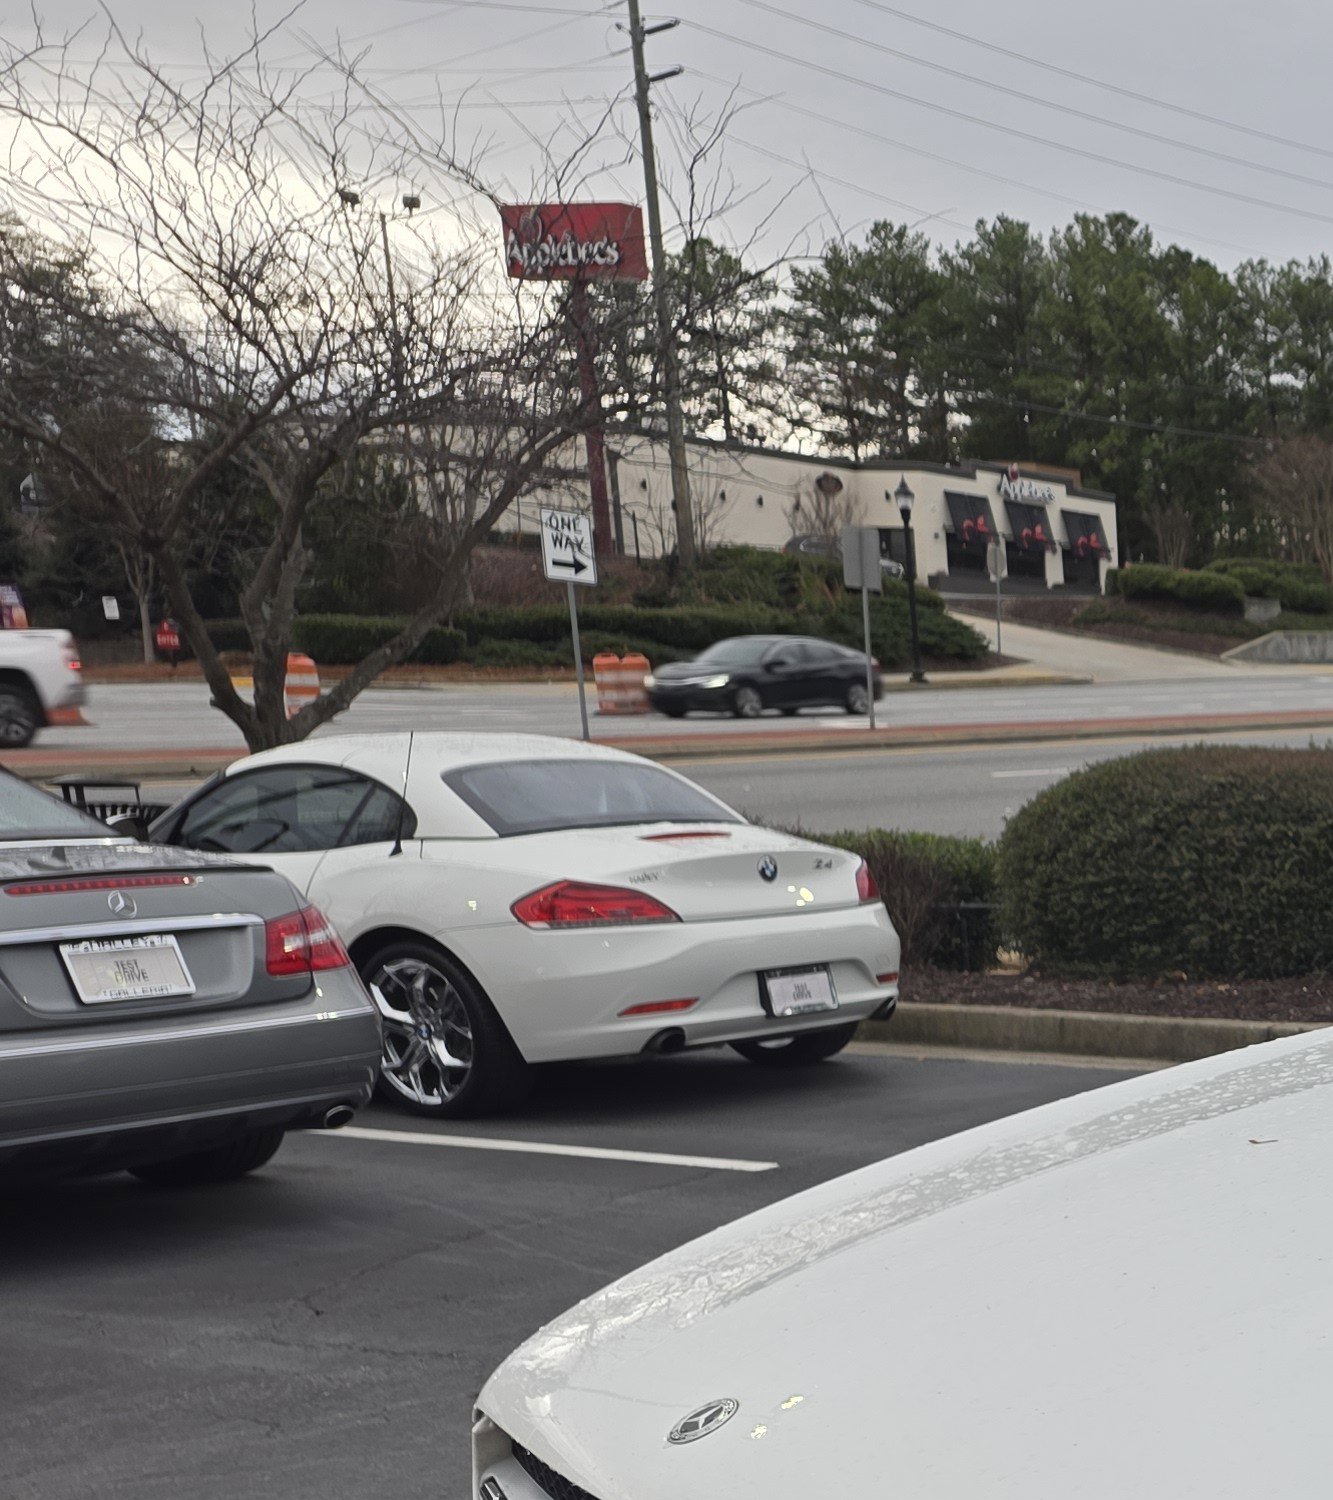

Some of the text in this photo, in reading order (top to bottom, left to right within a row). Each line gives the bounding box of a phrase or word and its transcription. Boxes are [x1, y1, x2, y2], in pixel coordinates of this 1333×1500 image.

[549, 514, 582, 535] ONE
[551, 533, 584, 550] WAY
[114, 959, 141, 974] TEST
[114, 968, 150, 984] DRIVE
